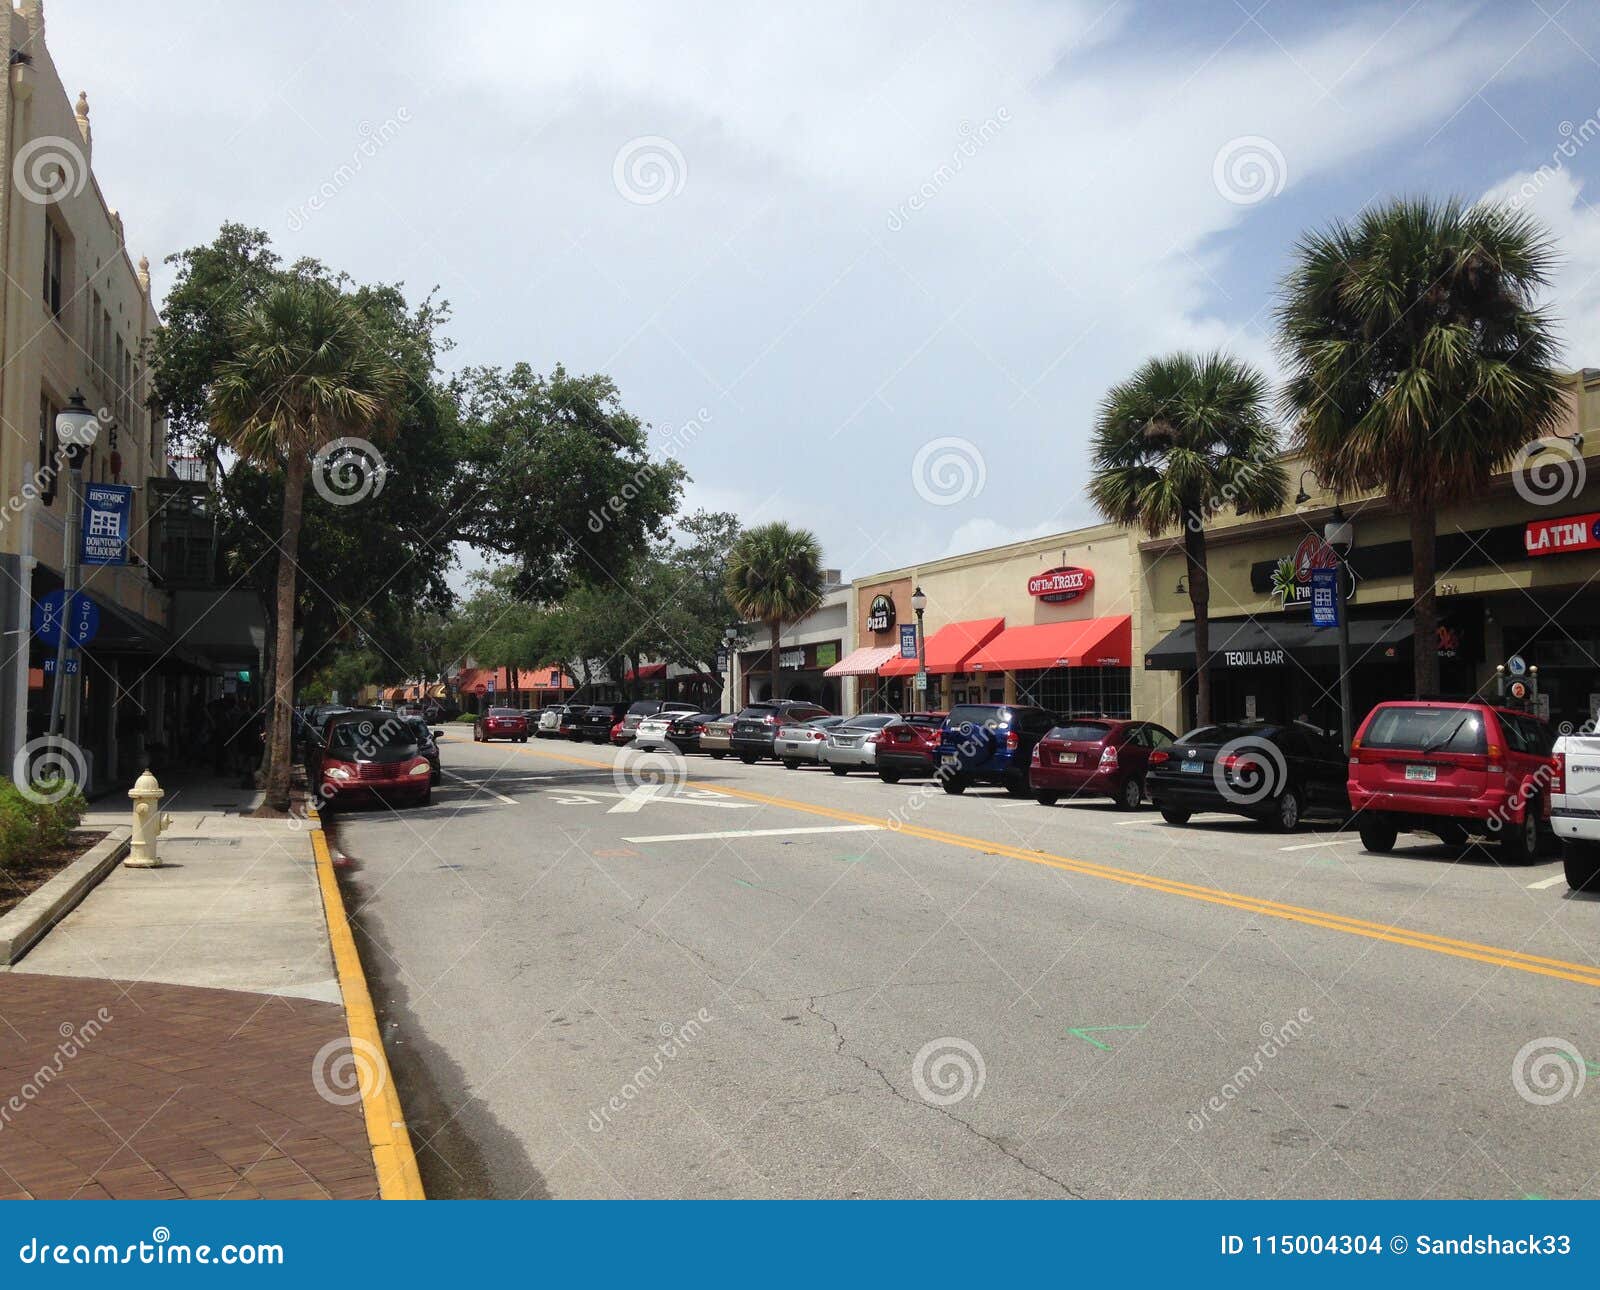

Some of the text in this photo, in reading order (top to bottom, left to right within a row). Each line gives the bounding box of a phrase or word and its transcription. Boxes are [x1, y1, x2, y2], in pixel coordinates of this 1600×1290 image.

[89, 491, 125, 504] HISTORIC
[86, 537, 121, 547] DOWNTOWN
[1526, 523, 1588, 551] LATIN
[85, 546, 121, 557] MELBOURNE
[80, 601, 91, 640] STOP
[1225, 650, 1285, 667] TEQUILA BAR
[44, 661, 78, 673] RT 26
